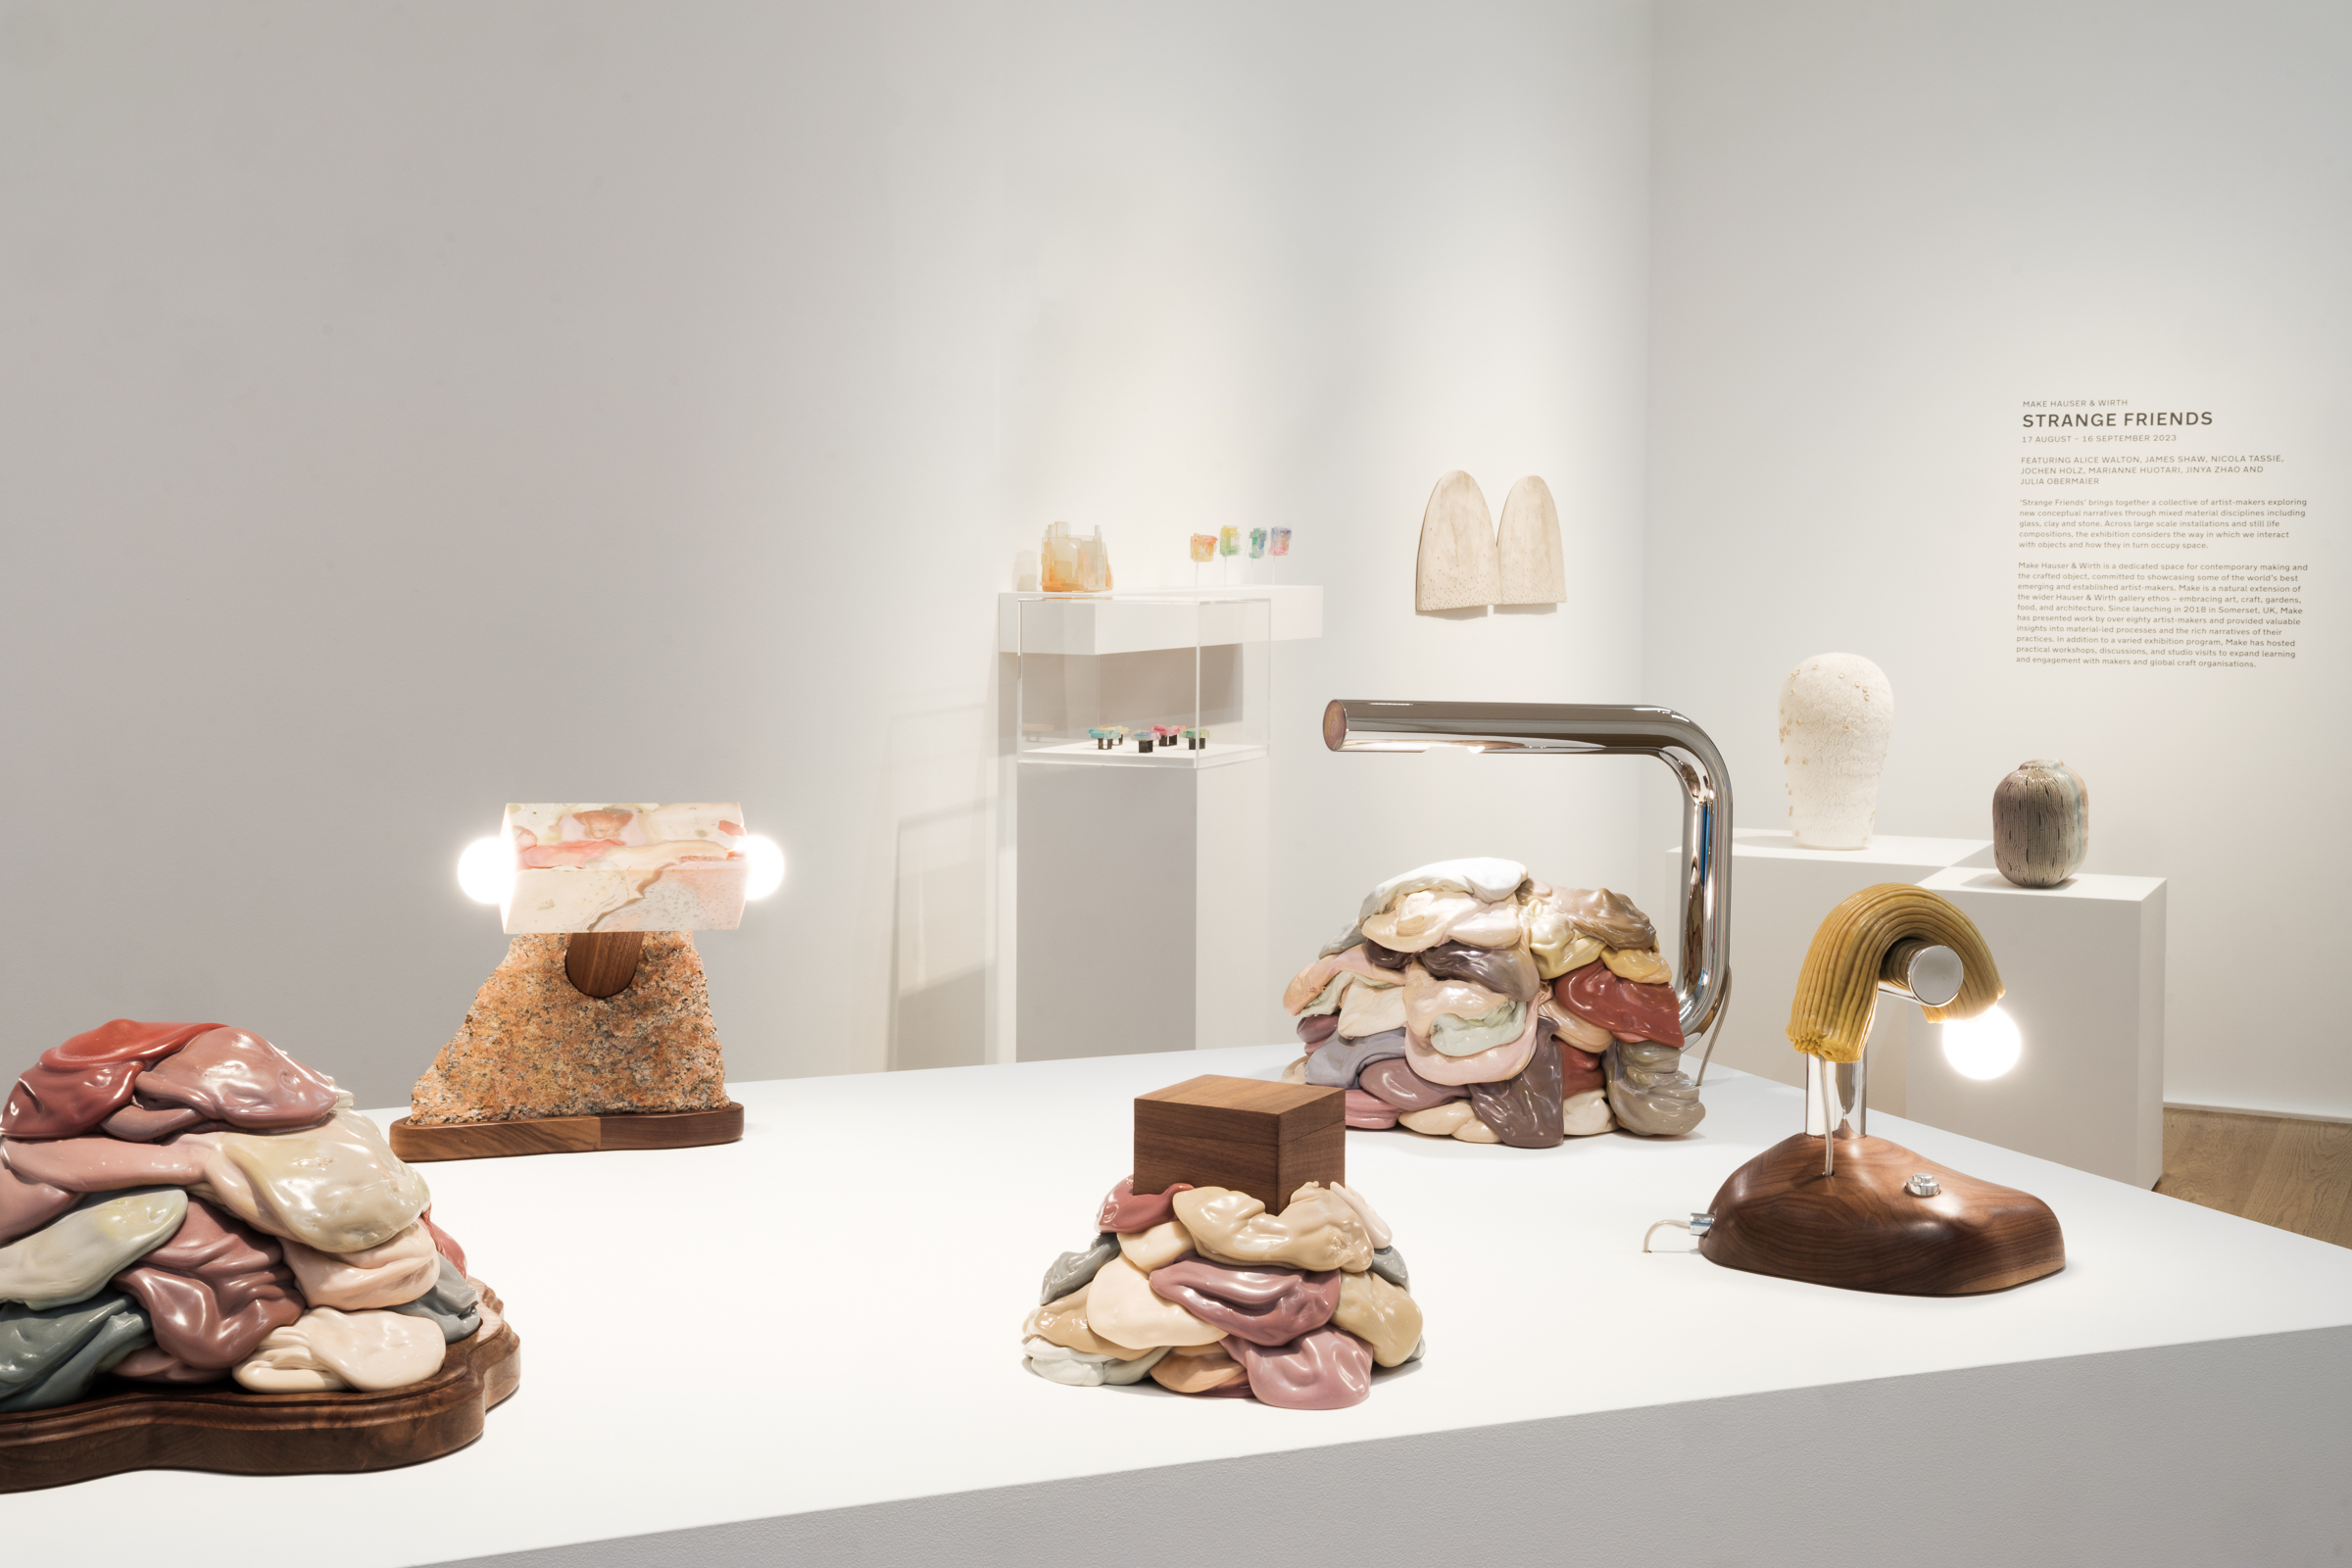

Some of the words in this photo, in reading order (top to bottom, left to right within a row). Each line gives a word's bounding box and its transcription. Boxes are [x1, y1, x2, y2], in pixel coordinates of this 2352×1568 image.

[2022, 413, 2117, 428] STRANGE
[2124, 412, 2213, 426] FRIENDS
[2260, 564, 2290, 572] making
